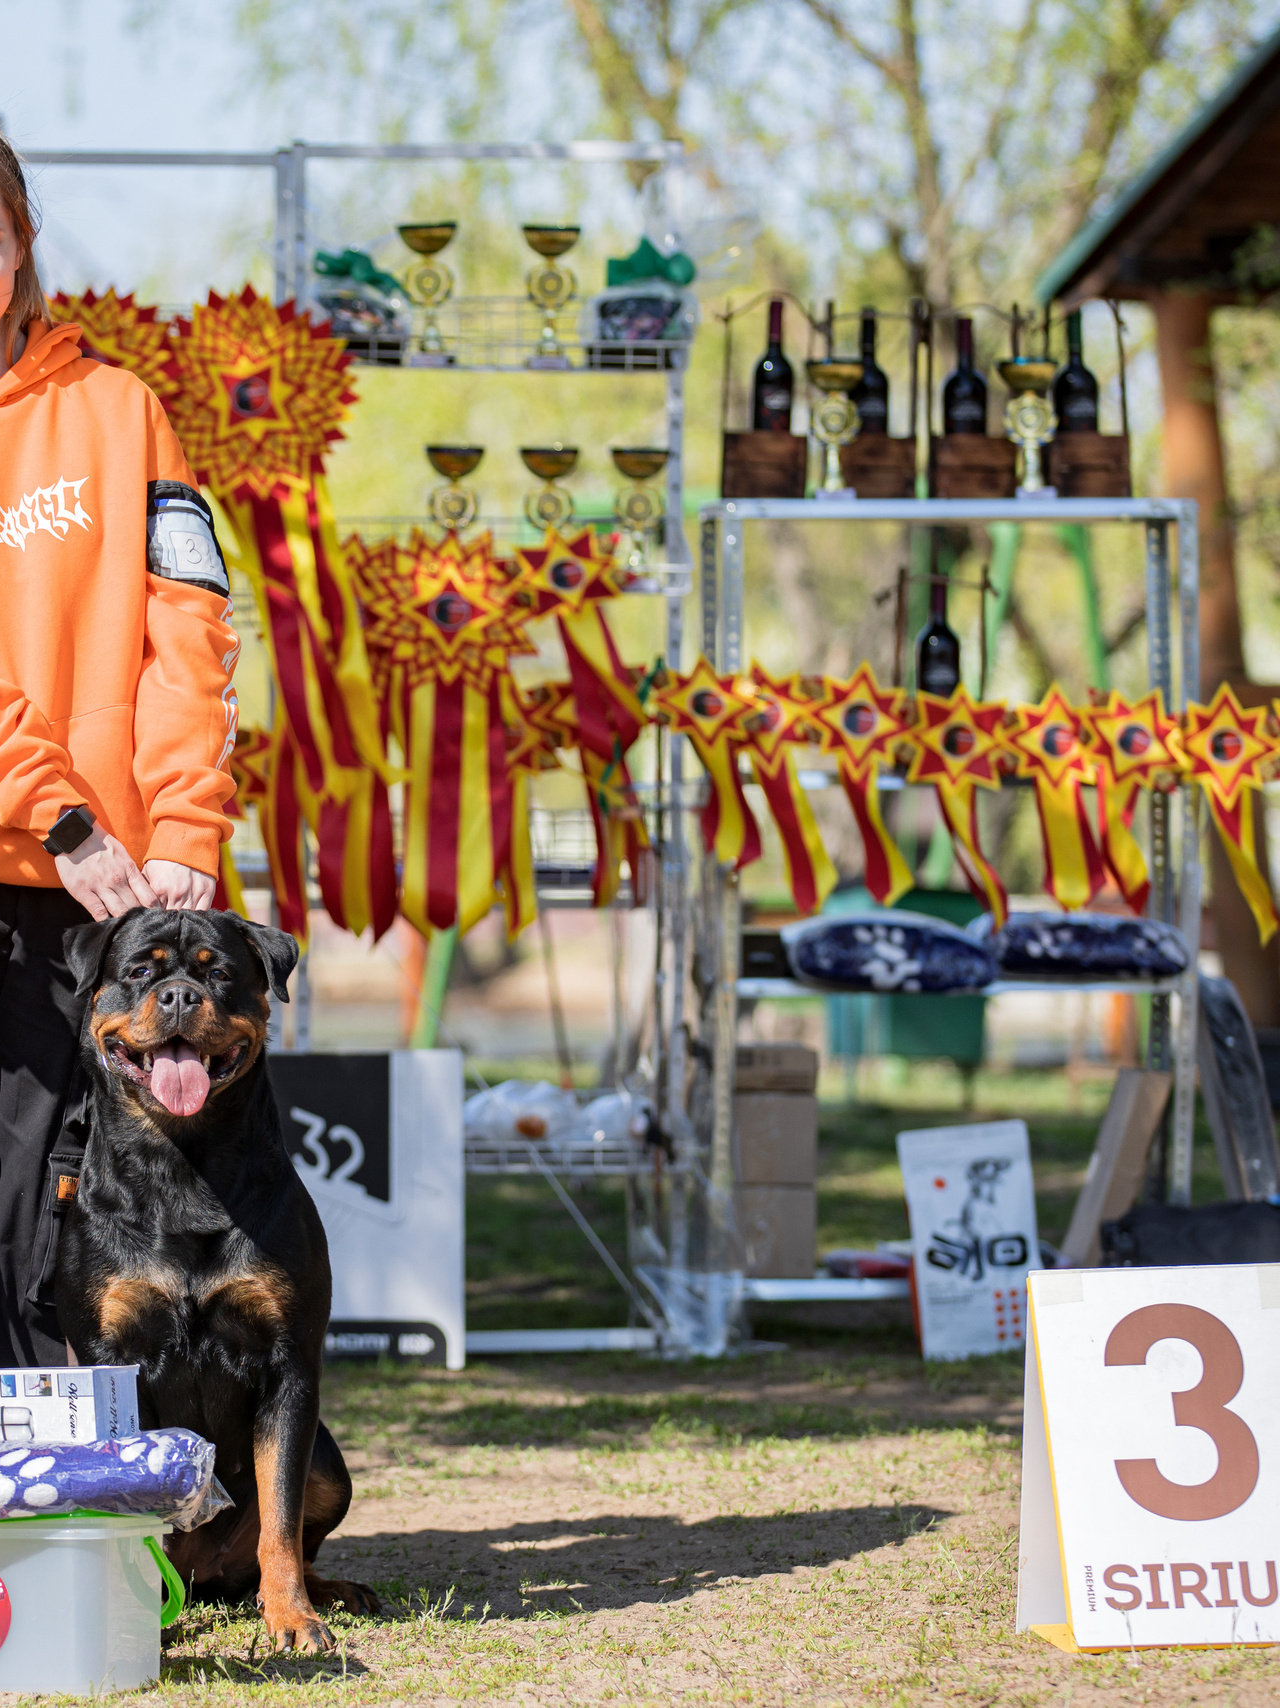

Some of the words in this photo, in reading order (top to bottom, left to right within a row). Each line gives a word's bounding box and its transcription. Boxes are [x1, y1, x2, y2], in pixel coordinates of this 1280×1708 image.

[289, 1106, 367, 1195] 32
[1104, 1302, 1260, 1522] 3
[1084, 1565, 1096, 1612] PREMIUM
[1102, 1560, 1280, 1611] SIRIU
